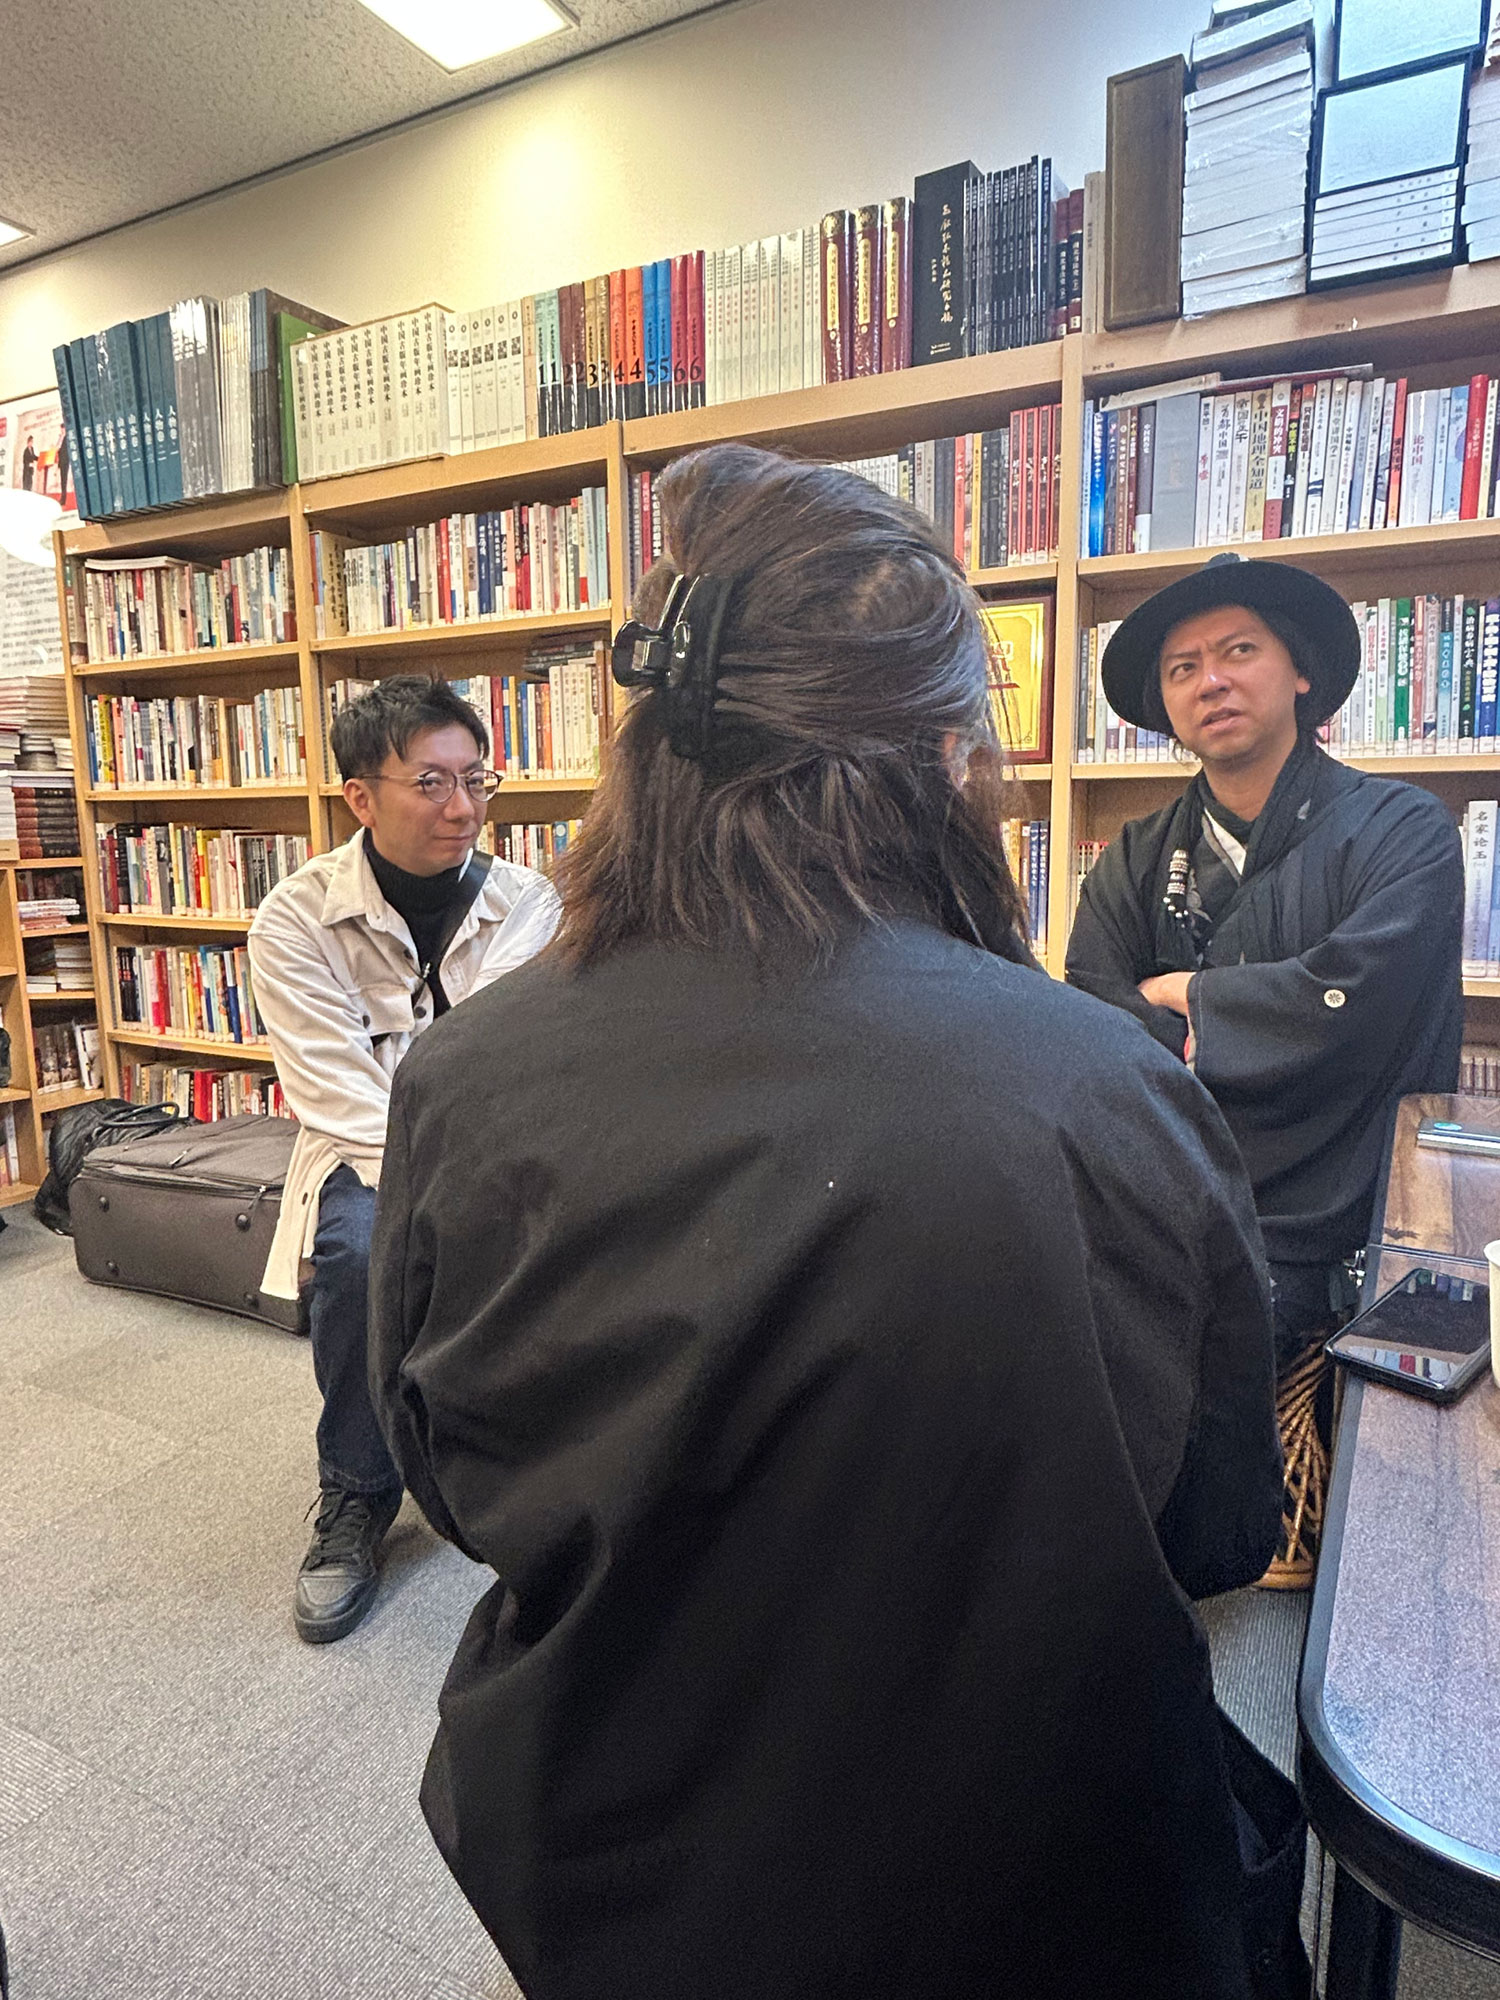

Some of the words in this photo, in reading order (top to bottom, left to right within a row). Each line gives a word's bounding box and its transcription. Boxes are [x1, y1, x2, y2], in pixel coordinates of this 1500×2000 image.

[538, 362, 546, 385] 1
[551, 361, 558, 383] 1
[564, 364, 573, 385] 2
[576, 361, 585, 382] 2
[589, 364, 598, 386] 3
[601, 360, 610, 383] 3
[614, 360, 625, 382] 4
[630, 357, 642, 379] 4
[647, 361, 656, 384] 5
[660, 358, 670, 381] 5
[674, 360, 686, 382] 6
[690, 357, 702, 380] 6
[1273, 408, 1286, 454] 文明的冲突
[1249, 410, 1268, 490] 中国地理全知道
[1411, 434, 1425, 466] 论中国
[1472, 810, 1489, 861] 名家论玉
